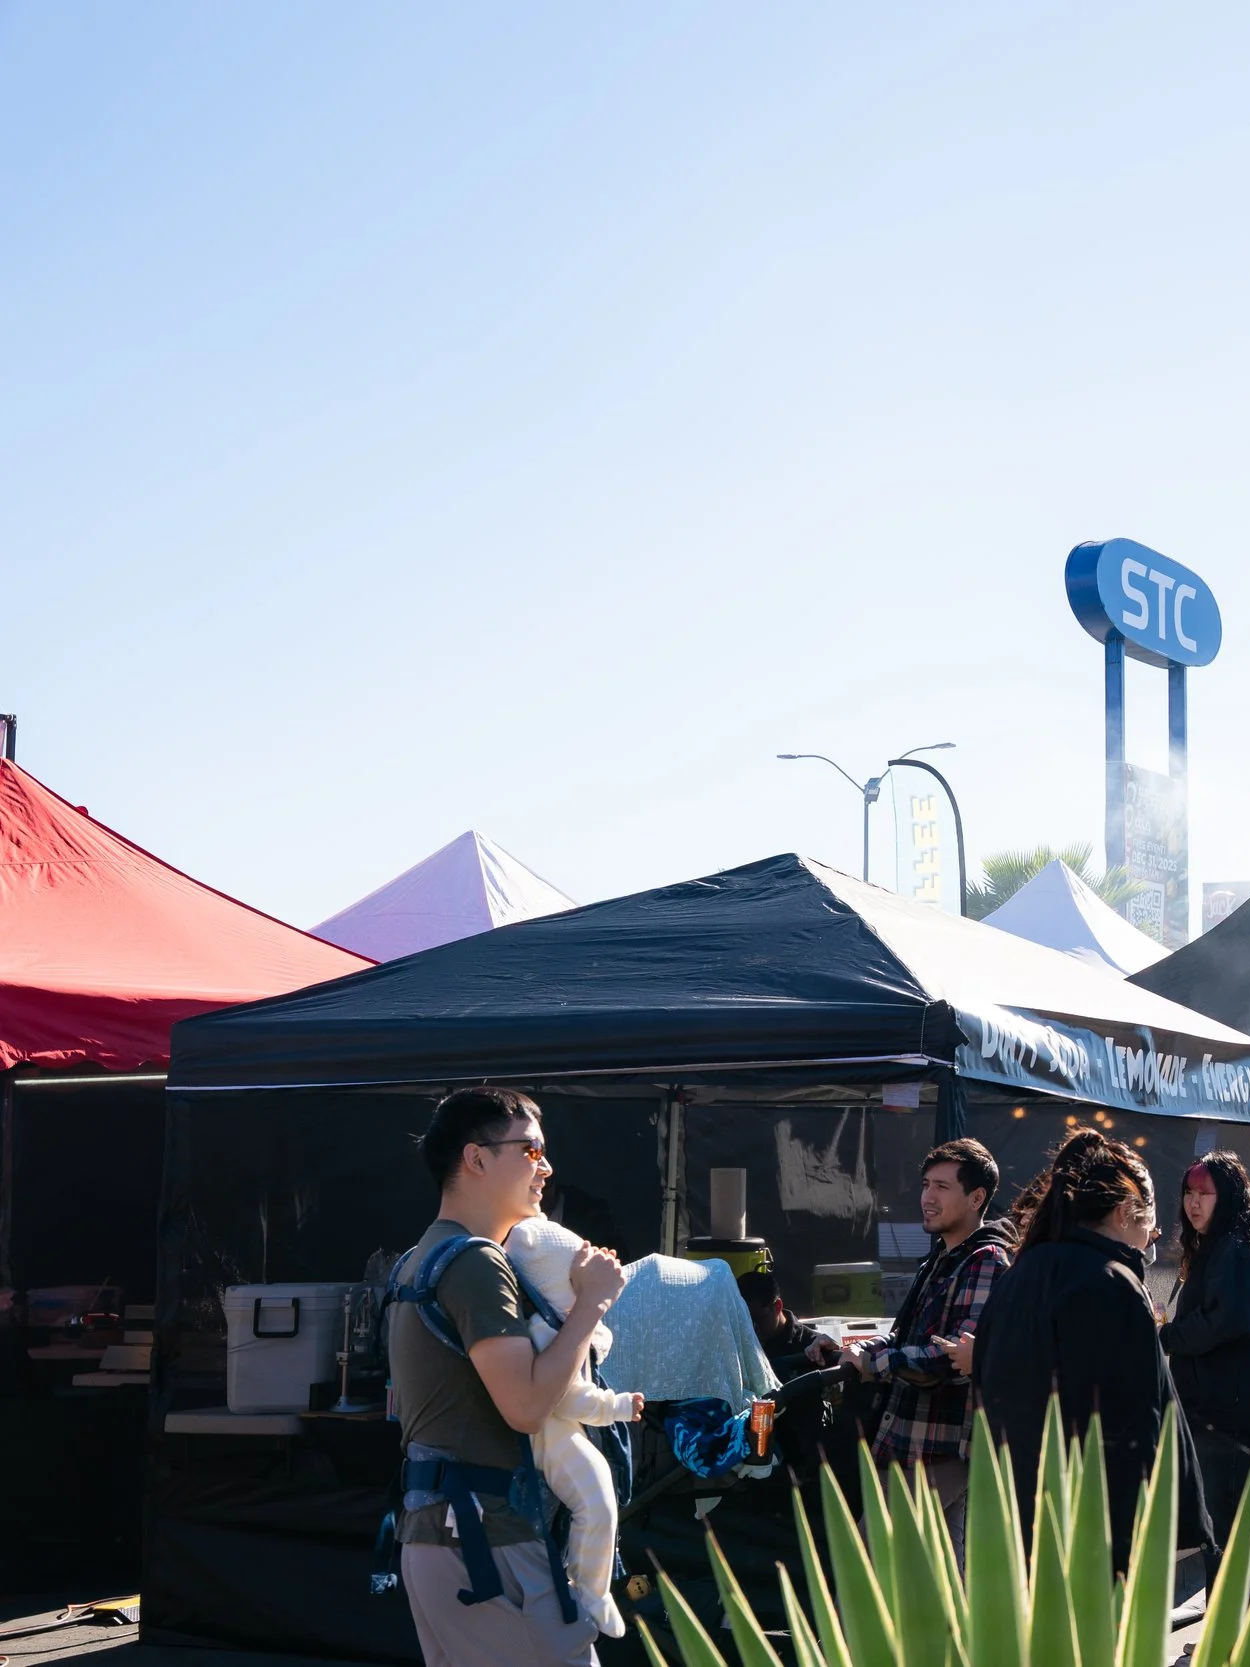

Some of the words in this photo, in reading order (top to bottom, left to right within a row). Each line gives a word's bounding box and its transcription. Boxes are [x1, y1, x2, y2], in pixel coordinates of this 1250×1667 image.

[1121, 557, 1197, 653] STC
[1132, 850, 1146, 865] DEC
[1158, 858, 1177, 872] 2025
[1045, 1026, 1090, 1080] SODA
[1105, 1037, 1187, 1098] LEMONADE
